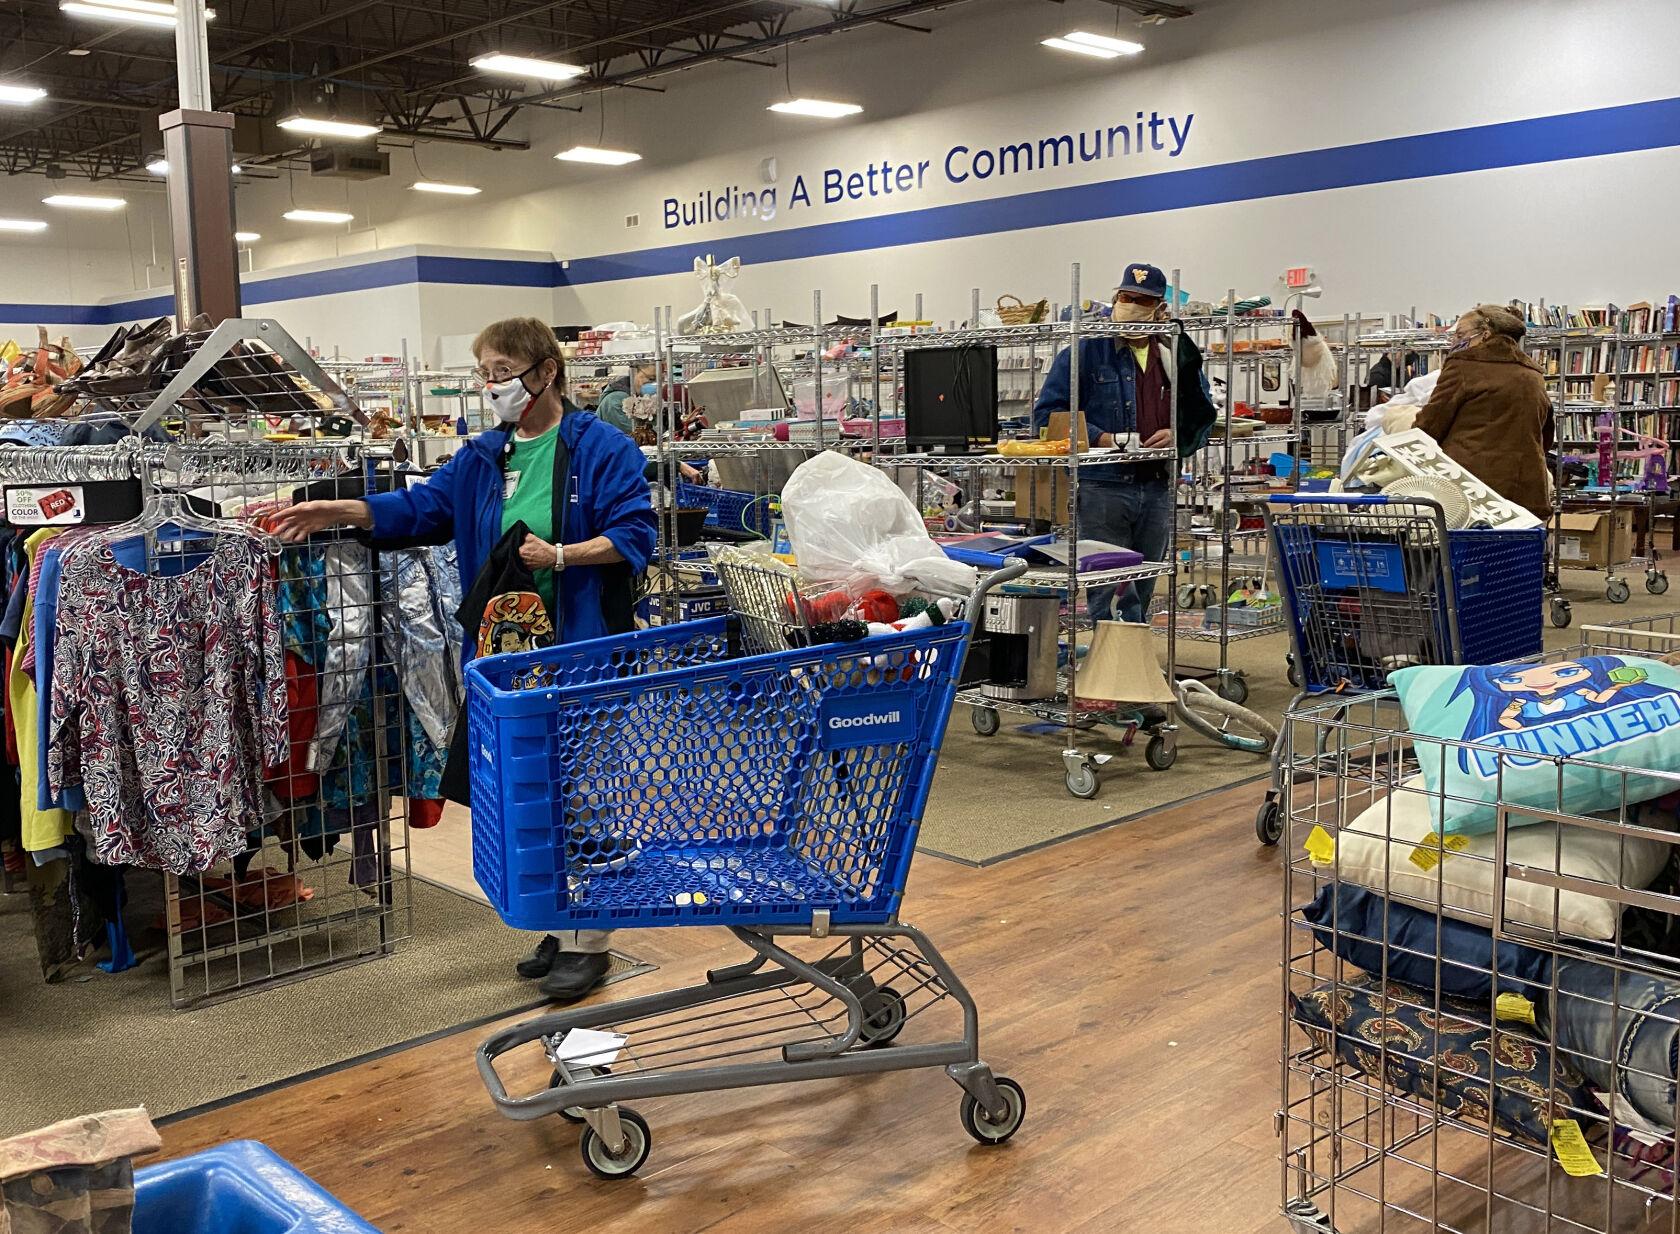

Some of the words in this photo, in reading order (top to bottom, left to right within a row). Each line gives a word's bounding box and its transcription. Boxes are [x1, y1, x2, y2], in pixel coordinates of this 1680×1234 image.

[664, 186, 776, 228] Building
[788, 174, 812, 210] A
[824, 160, 930, 204] Better
[945, 111, 1195, 183] Community
[1288, 269, 1307, 286] EXIT
[16, 489, 32, 497] 50%
[50, 499, 66, 509] RED
[490, 594, 538, 623] Sick
[649, 598, 660, 606] JVC
[691, 602, 711, 613] JVC
[829, 711, 900, 729] Goodwill
[1472, 696, 1680, 778] FUNNEH
